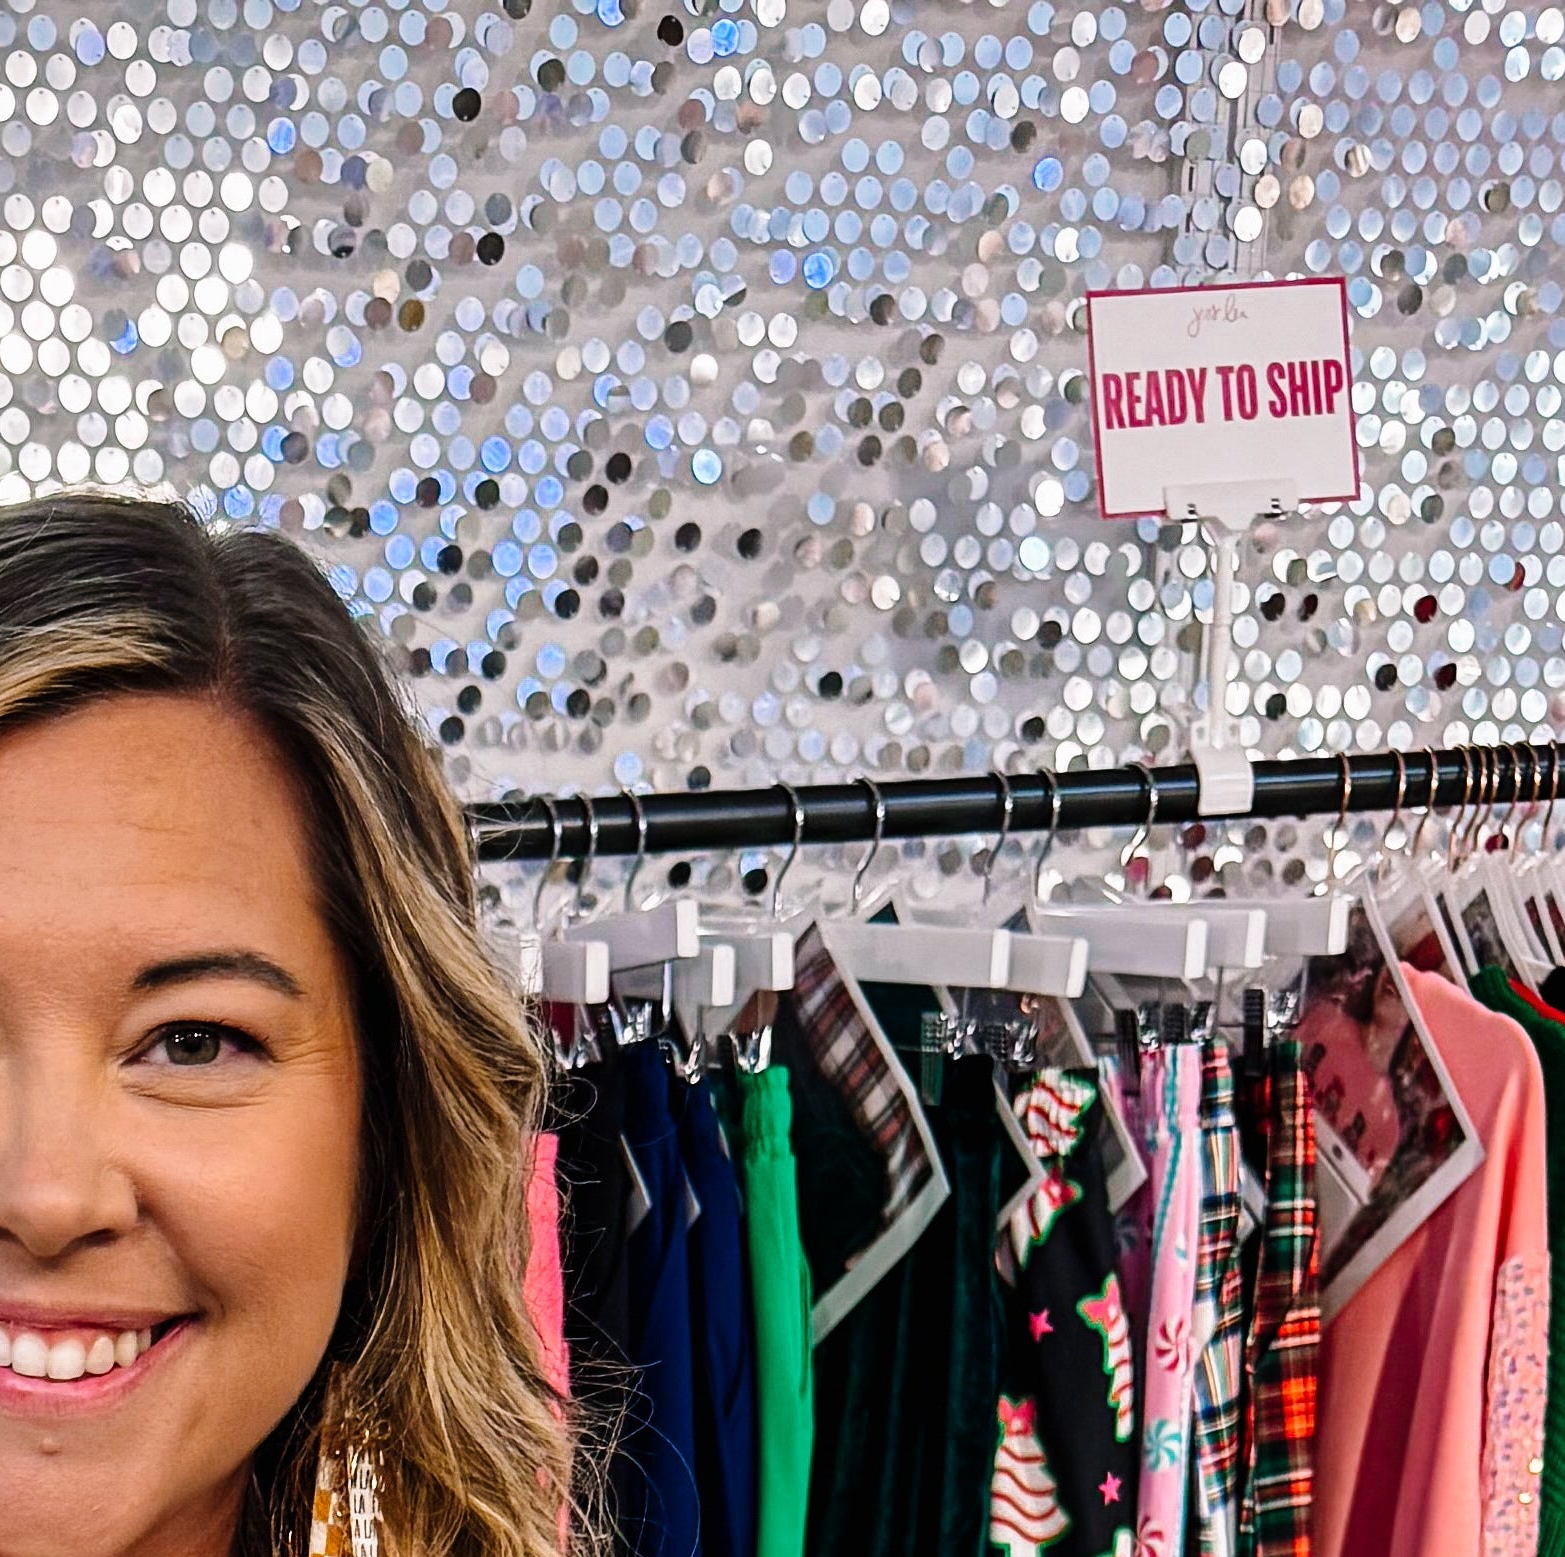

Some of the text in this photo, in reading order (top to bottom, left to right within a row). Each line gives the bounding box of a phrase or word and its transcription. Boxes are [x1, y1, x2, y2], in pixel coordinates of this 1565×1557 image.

[1102, 359, 1344, 430] READY TO SHIP
